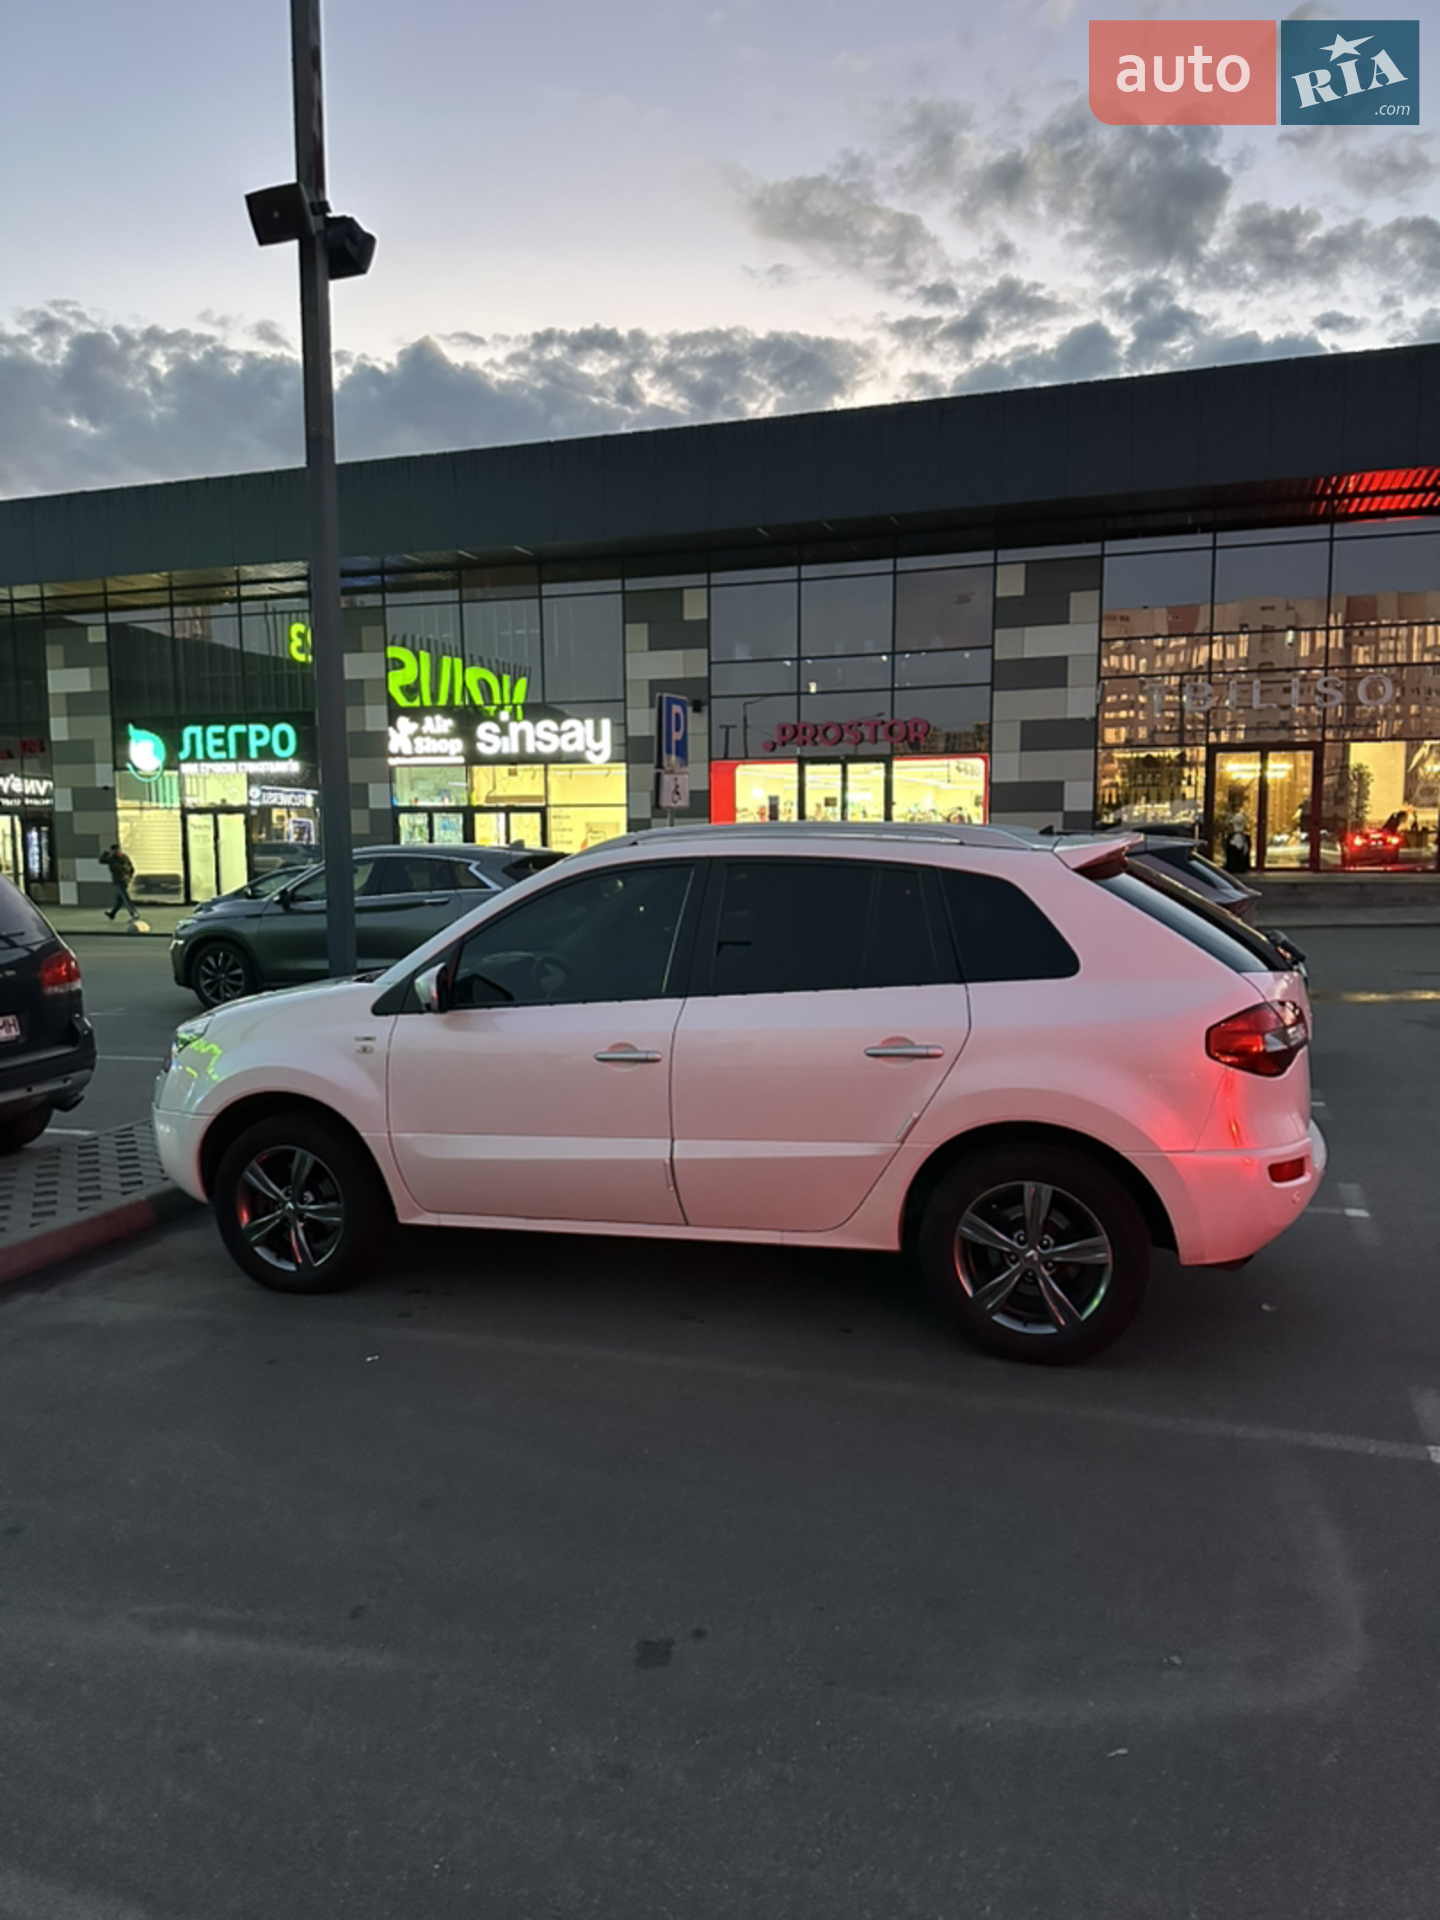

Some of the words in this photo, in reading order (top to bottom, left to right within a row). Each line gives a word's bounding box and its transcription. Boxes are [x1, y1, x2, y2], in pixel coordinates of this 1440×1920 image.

[1143, 673, 1395, 718] TBILISO
[178, 722, 297, 761] ЛЕГРО
[421, 714, 454, 734] Air
[475, 711, 612, 764] sinsay
[671, 703, 685, 761] P
[413, 735, 463, 756] Shop
